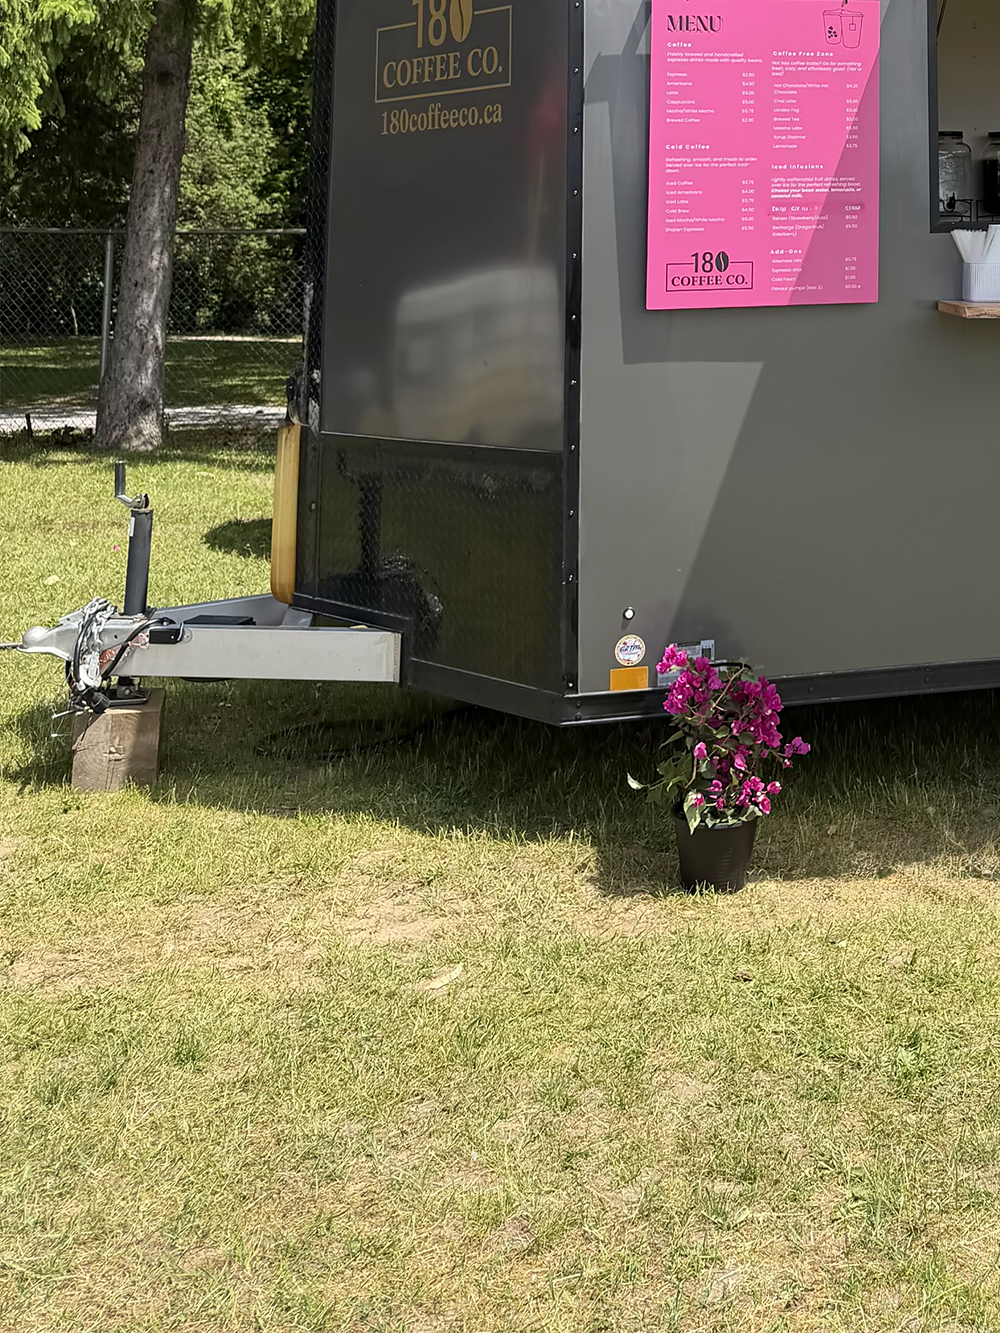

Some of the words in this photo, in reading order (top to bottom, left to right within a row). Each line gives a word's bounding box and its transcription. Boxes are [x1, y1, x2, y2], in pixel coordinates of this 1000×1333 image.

[667, 15, 723, 33] MENU
[383, 52, 461, 89] COFFEE
[467, 45, 503, 77] CO.
[381, 103, 503, 136] 180coffeeco.ca
[691, 251, 729, 273] 180
[671, 274, 722, 287] COFFEE
[726, 274, 748, 285] CO.
